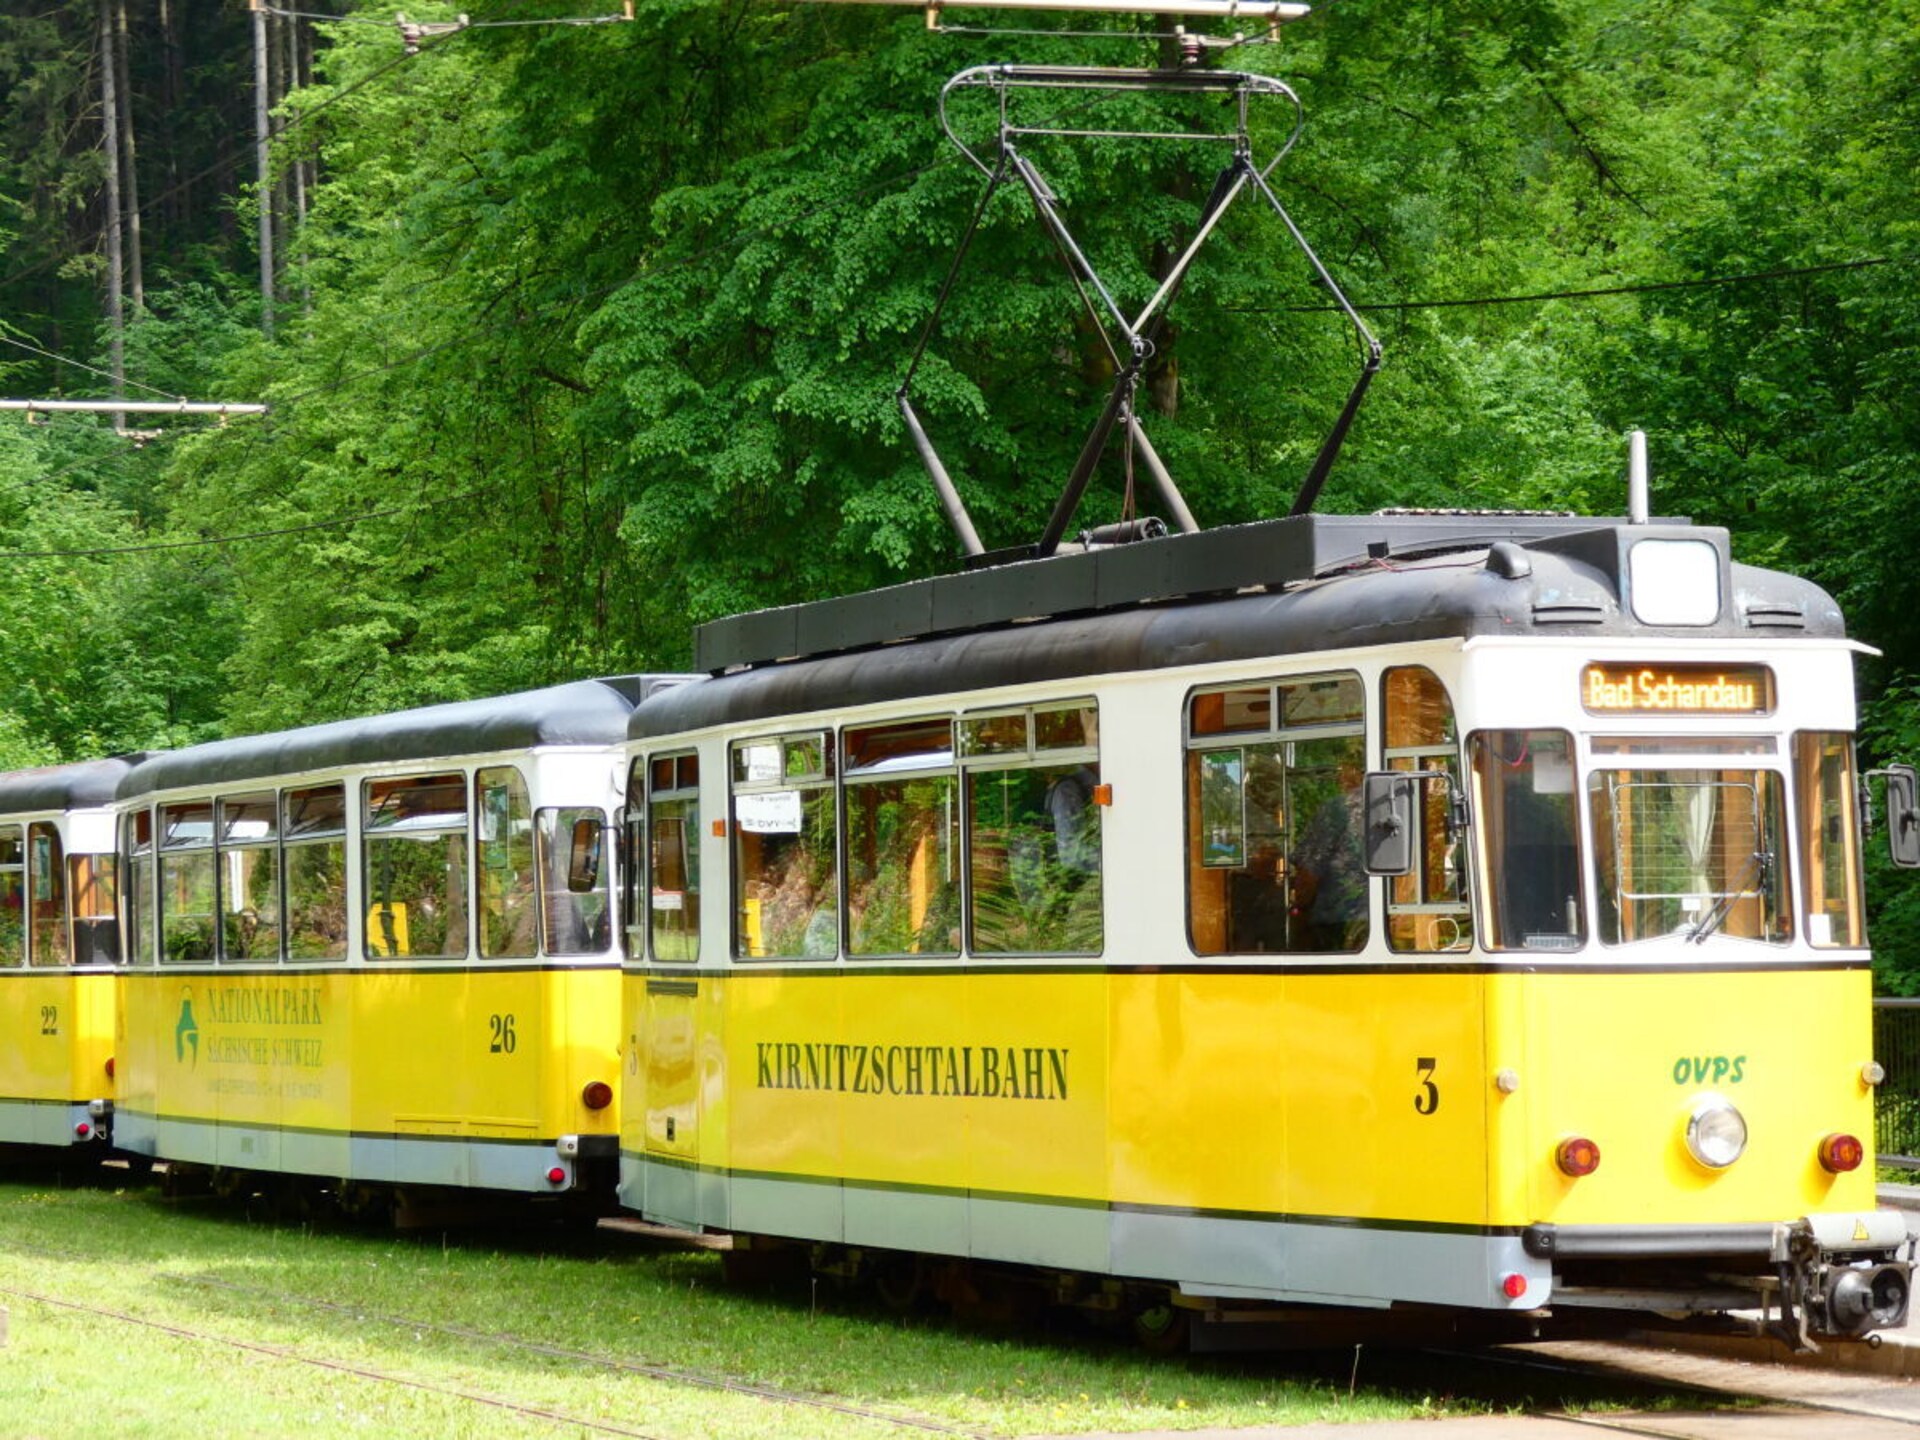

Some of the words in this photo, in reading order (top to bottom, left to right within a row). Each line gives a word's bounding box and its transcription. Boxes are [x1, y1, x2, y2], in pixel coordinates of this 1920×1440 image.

[1588, 669, 1632, 708] Bad
[1638, 670, 1754, 709] Schandau
[41, 1005, 57, 1036] 22
[206, 987, 323, 1025] NATIONALPARK
[272, 1038, 323, 1067] SCHWEIZ
[490, 1013, 516, 1054] 26
[756, 1042, 1069, 1101] KIRNITZSCHTALBAHN
[1414, 1056, 1440, 1116] 3
[1673, 1055, 1747, 1086] OVPS
